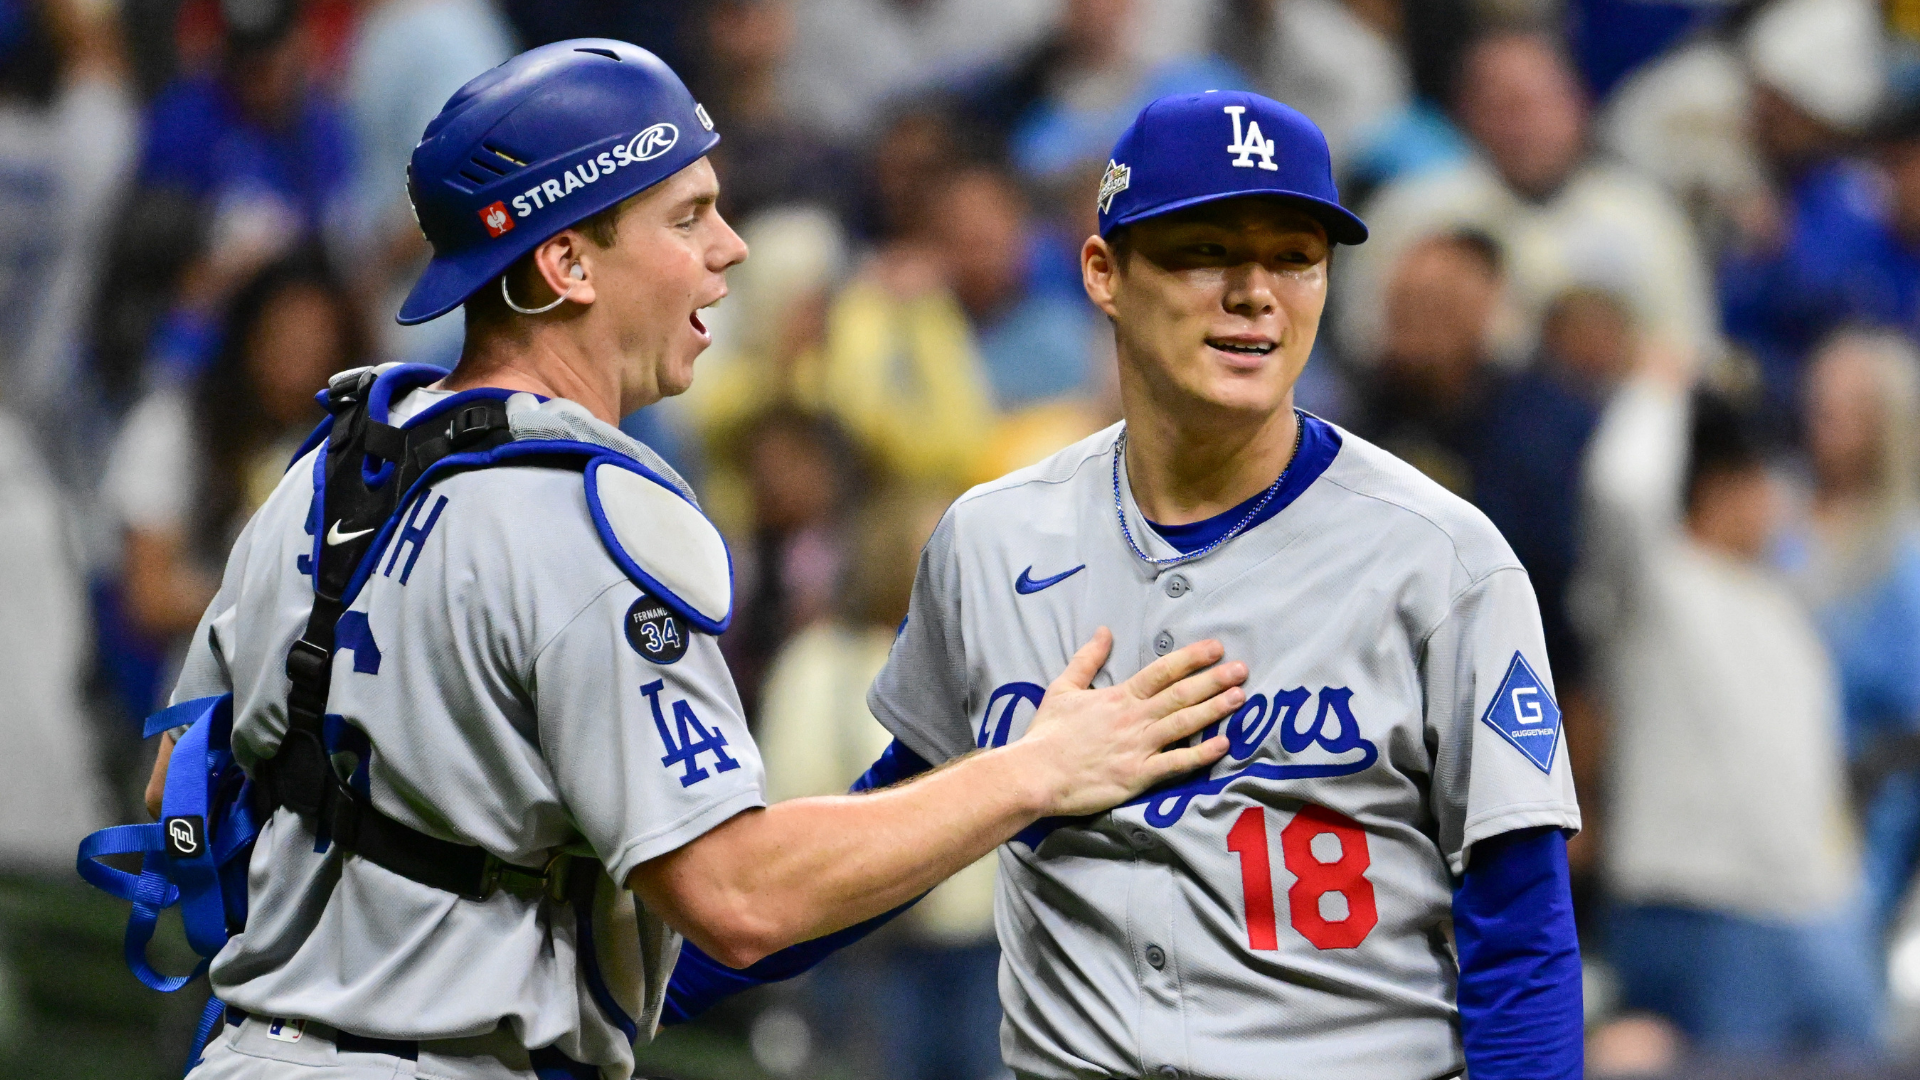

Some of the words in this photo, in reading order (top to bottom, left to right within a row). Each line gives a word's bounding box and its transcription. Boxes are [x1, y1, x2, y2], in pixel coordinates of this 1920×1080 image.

[1224, 106, 1278, 171] LA
[511, 144, 632, 218] STRAUSS
[633, 607, 669, 623] FERNAND
[640, 617, 681, 653] 34
[1511, 687, 1543, 724] G
[640, 678, 741, 788] LA
[1511, 728, 1554, 738] GUGGENHEIM
[1226, 803, 1379, 951] 18
